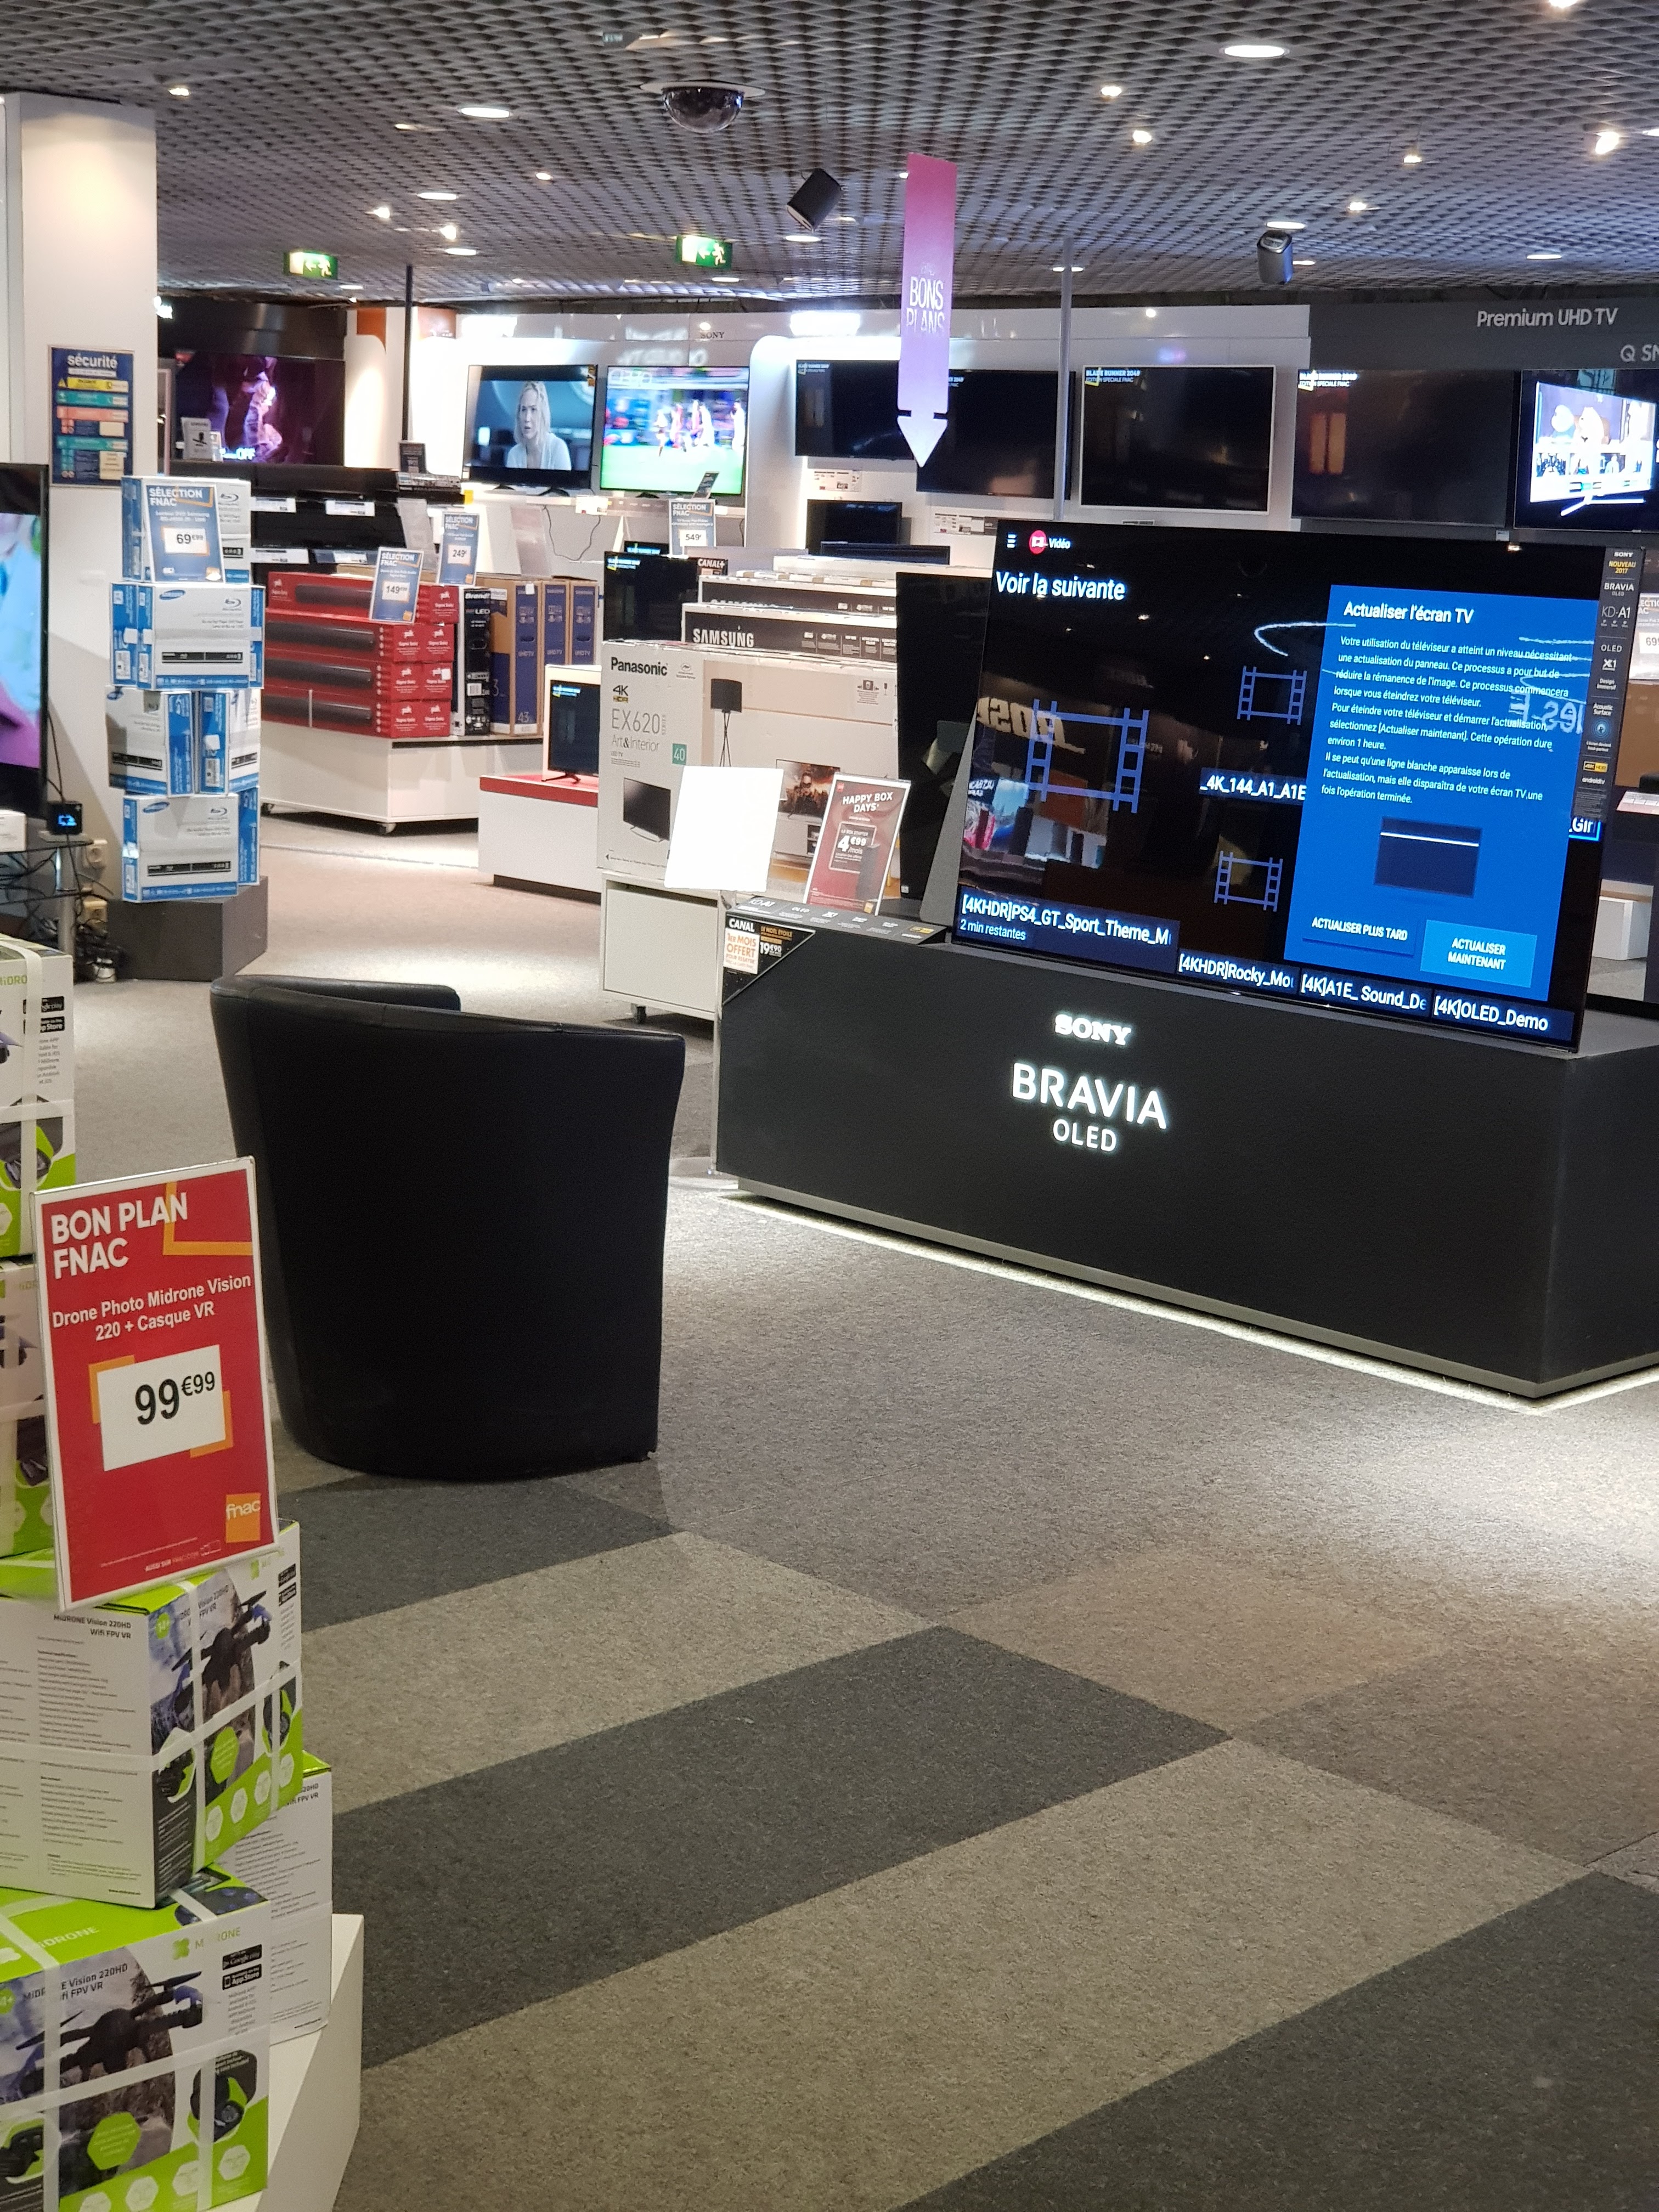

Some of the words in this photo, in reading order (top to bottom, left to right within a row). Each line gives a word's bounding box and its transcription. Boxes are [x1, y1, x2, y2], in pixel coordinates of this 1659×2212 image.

[909, 276, 944, 310] BONS
[1477, 308, 1554, 327] Premium
[1558, 308, 1592, 326] UHD
[1594, 307, 1619, 325] TV
[67, 352, 118, 369] sécurité
[1620, 344, 1637, 363] Q
[148, 486, 203, 499] SÉLECTION
[149, 498, 177, 506] FNAC
[1048, 537, 1071, 549] Vidéo
[697, 558, 726, 568] CANAL+
[996, 571, 1030, 594] Voir
[1032, 572, 1048, 595] la
[1051, 575, 1126, 601] suivante
[1604, 583, 1635, 591] BRAVIA
[1344, 601, 1409, 620] Actualiser
[1409, 604, 1452, 623] l'écran
[1455, 608, 1475, 624] TV
[1601, 606, 1631, 619] KD-A1
[693, 628, 754, 648] SAMSUNG
[1600, 644, 1623, 652] OLED
[1340, 636, 1361, 646] Votre
[1362, 637, 1398, 649] utilisation
[1400, 640, 1410, 650] du
[1412, 641, 1450, 653] téléviseur
[1458, 645, 1483, 655] atteint
[1497, 647, 1523, 658] niveau
[1525, 649, 1573, 662] nécessitant
[611, 656, 668, 676] Panasonic
[1338, 654, 1352, 663] une
[1353, 655, 1402, 666] actualisation
[1403, 657, 1414, 667] du
[1414, 660, 1450, 670] panneau.
[1452, 661, 1464, 672] Ce
[1464, 664, 1505, 675] processus
[1513, 667, 1533, 678] pour
[612, 685, 629, 696] 4K
[1336, 669, 1362, 680] réduire
[1372, 672, 1415, 685] rémanence
[1428, 676, 1458, 689] l'image.
[1472, 682, 1513, 693] processus
[1514, 686, 1569, 697] commencera
[1334, 686, 1362, 698] lorsque
[1363, 689, 1382, 698] vous
[1383, 690, 1419, 702] éteindrez
[1420, 694, 1441, 703] votre
[1442, 696, 1482, 708] téléviseur.
[612, 708, 661, 735] EX620
[1331, 702, 1350, 713] Pour
[1351, 704, 1382, 715] éteindre
[1383, 708, 1403, 717] votre
[1404, 709, 1443, 721] téléviseur
[1453, 713, 1489, 726] démarrer
[1327, 736, 1355, 747] environ
[1363, 738, 1386, 750] heure.
[1329, 719, 1377, 732] sélectionnez
[1378, 721, 1420, 736] [Actualiser
[1470, 732, 1492, 743] Cette
[1493, 735, 1532, 747] opération
[1533, 738, 1553, 749] dure
[673, 747, 686, 761] 40
[1342, 755, 1359, 764] peut
[1361, 756, 1385, 766] qu'une
[1386, 758, 1405, 770] ligne
[1407, 759, 1437, 772] blanche
[1438, 764, 1481, 777] apparaisse
[1483, 768, 1498, 778] lors
[1321, 785, 1335, 795] fois
[1336, 786, 1375, 800] l'opération
[1377, 791, 1413, 804] terminée.
[1377, 775, 1396, 785] mais
[1398, 776, 1412, 787] elle
[1413, 777, 1454, 791] disparaîtra
[1468, 785, 1488, 795] votre
[1490, 786, 1513, 797] écran
[842, 794, 872, 805] HAPPY
[873, 791, 894, 802] BOX
[728, 918, 755, 933] CANAL
[960, 919, 966, 930] 2
[967, 921, 984, 934] min
[985, 924, 1026, 941] restantes
[1311, 917, 1362, 935] ACTUALISER
[1362, 924, 1384, 938] PLUS
[1385, 927, 1408, 941] TARD
[726, 944, 756, 958] OFFERT
[737, 935, 757, 947] MOIS
[1451, 937, 1506, 955] ACTUALISER
[1447, 951, 1506, 970] MAINTENANT
[1054, 1014, 1132, 1046] SONY
[1012, 1062, 1167, 1130] BRAVIA
[1053, 1119, 1117, 1152] OLED
[51, 1205, 111, 1245] BON
[118, 1192, 188, 1232] PLAN
[53, 1237, 129, 1280] FNAC
[52, 1306, 98, 1329] Drone
[100, 1295, 144, 1317] Photo
[148, 1284, 205, 1308] Midrone
[207, 1274, 251, 1294] Vision
[95, 1323, 121, 1341] 220
[124, 1320, 134, 1332] +
[137, 1307, 191, 1332] Casque
[193, 1301, 215, 1319] VR
[225, 1499, 262, 1521] fnac
[87, 1618, 108, 1627] Vision
[109, 1620, 131, 1629] 220HD
[90, 1628, 105, 1637] Wifi
[106, 1629, 120, 1638] FPV
[297, 1795, 309, 1804] FPV
[69, 1973, 97, 1988] Vision
[99, 1963, 128, 1978] 220HD
[70, 1987, 88, 1999] FPV
[91, 1982, 103, 1992] VR
